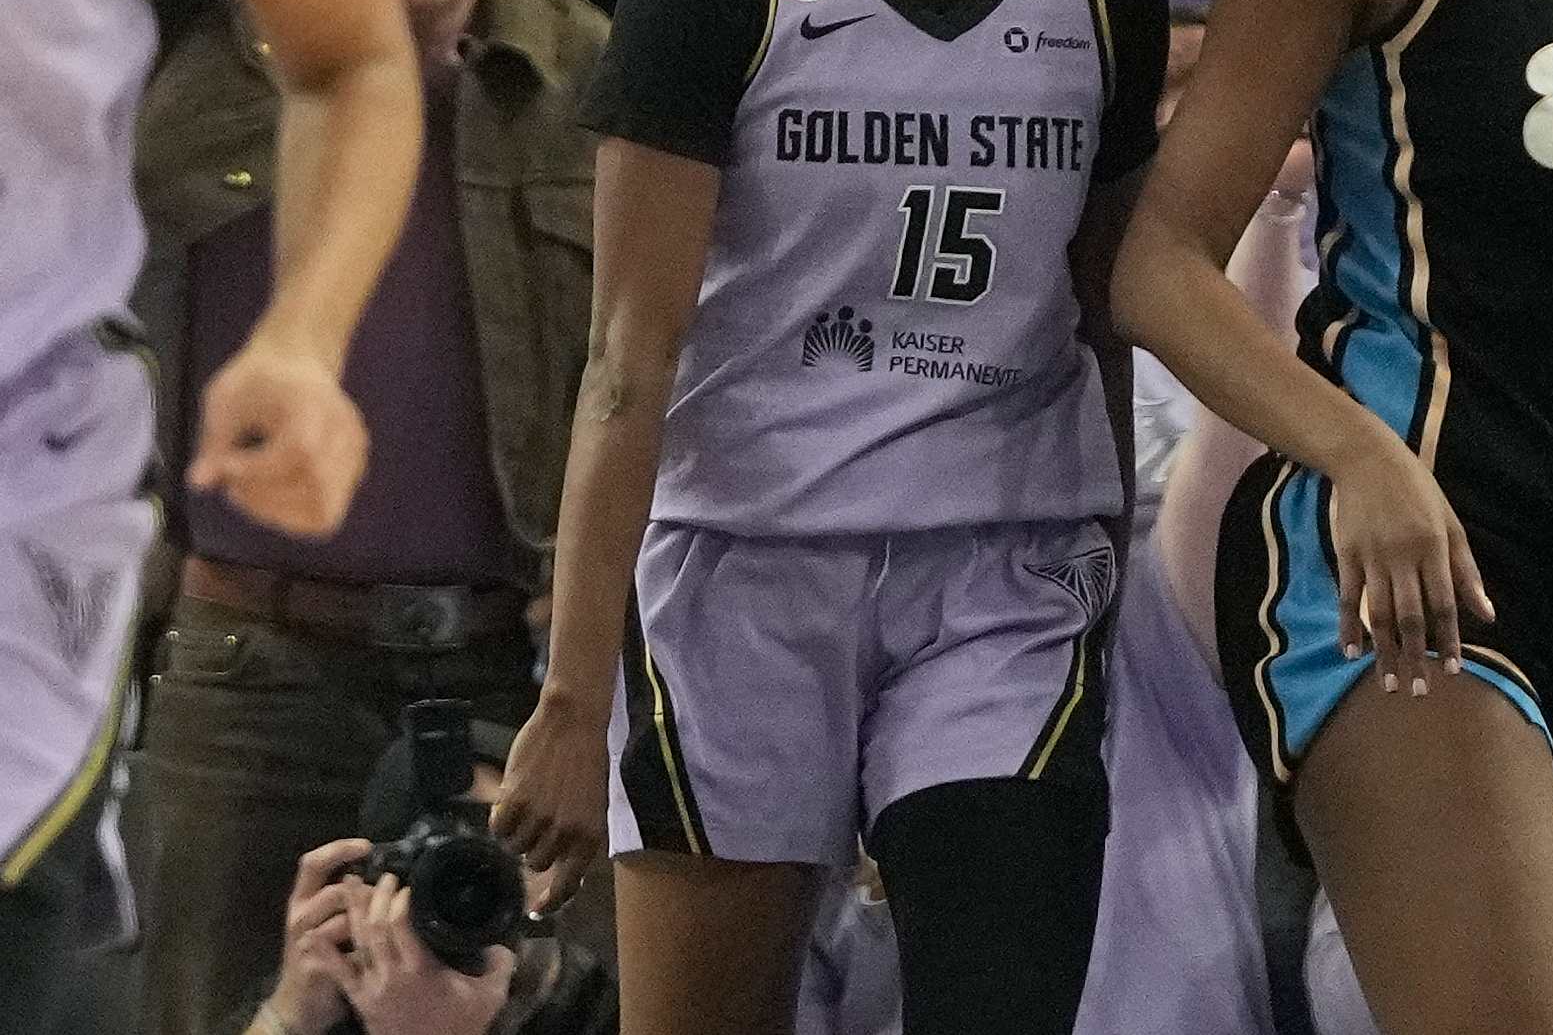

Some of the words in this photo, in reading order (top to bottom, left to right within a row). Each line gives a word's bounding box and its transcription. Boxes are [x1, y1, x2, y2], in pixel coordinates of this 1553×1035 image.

[1034, 30, 1091, 53] freedom
[776, 108, 949, 166] GOLDEN
[970, 114, 1083, 171] STATE
[888, 184, 1006, 306] 15
[891, 331, 966, 356] KAISER
